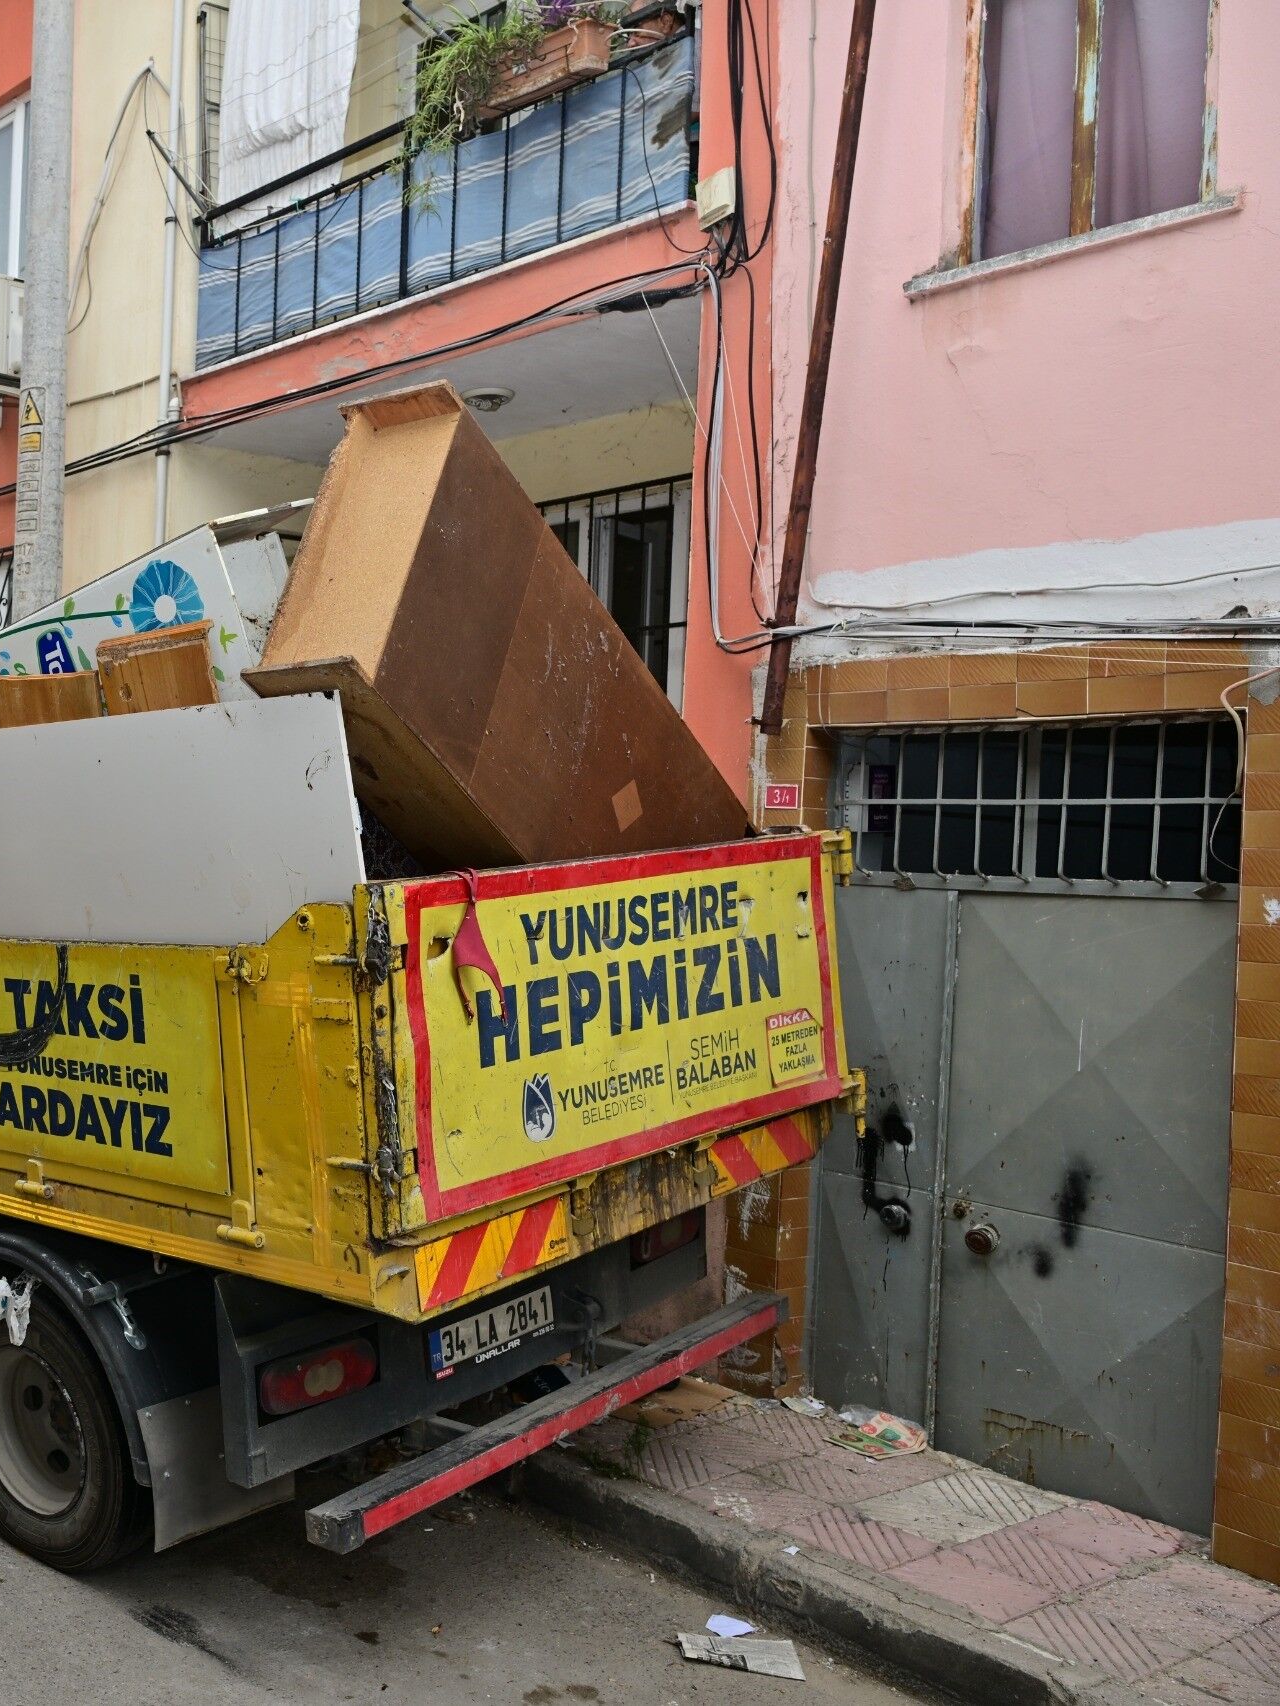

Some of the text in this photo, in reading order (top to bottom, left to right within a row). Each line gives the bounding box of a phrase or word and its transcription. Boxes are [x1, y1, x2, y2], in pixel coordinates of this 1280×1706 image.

[773, 789, 790, 804] 3/1
[519, 880, 738, 965] YUNUSEMRE
[4, 974, 146, 1044] TAKSİ
[475, 934, 781, 1069] HEPİMİZİN
[769, 1010, 810, 1029] DİKKA
[771, 1025, 818, 1047] 25 METREDEN
[691, 1028, 740, 1061] SEMİH
[785, 1043, 808, 1057] FAZLA
[7, 1053, 122, 1087] UNUSEMRE
[125, 1065, 169, 1097] İÇİN
[676, 1048, 757, 1090] BALABAN
[779, 1054, 816, 1073] YAKLAŞMA
[558, 1064, 665, 1112] YUNUSEMRE
[582, 1093, 647, 1126] BELEDİYESİ
[432, 1291, 549, 1364] TR 34 LA 2841
[435, 1367, 455, 1380] ISUZU
